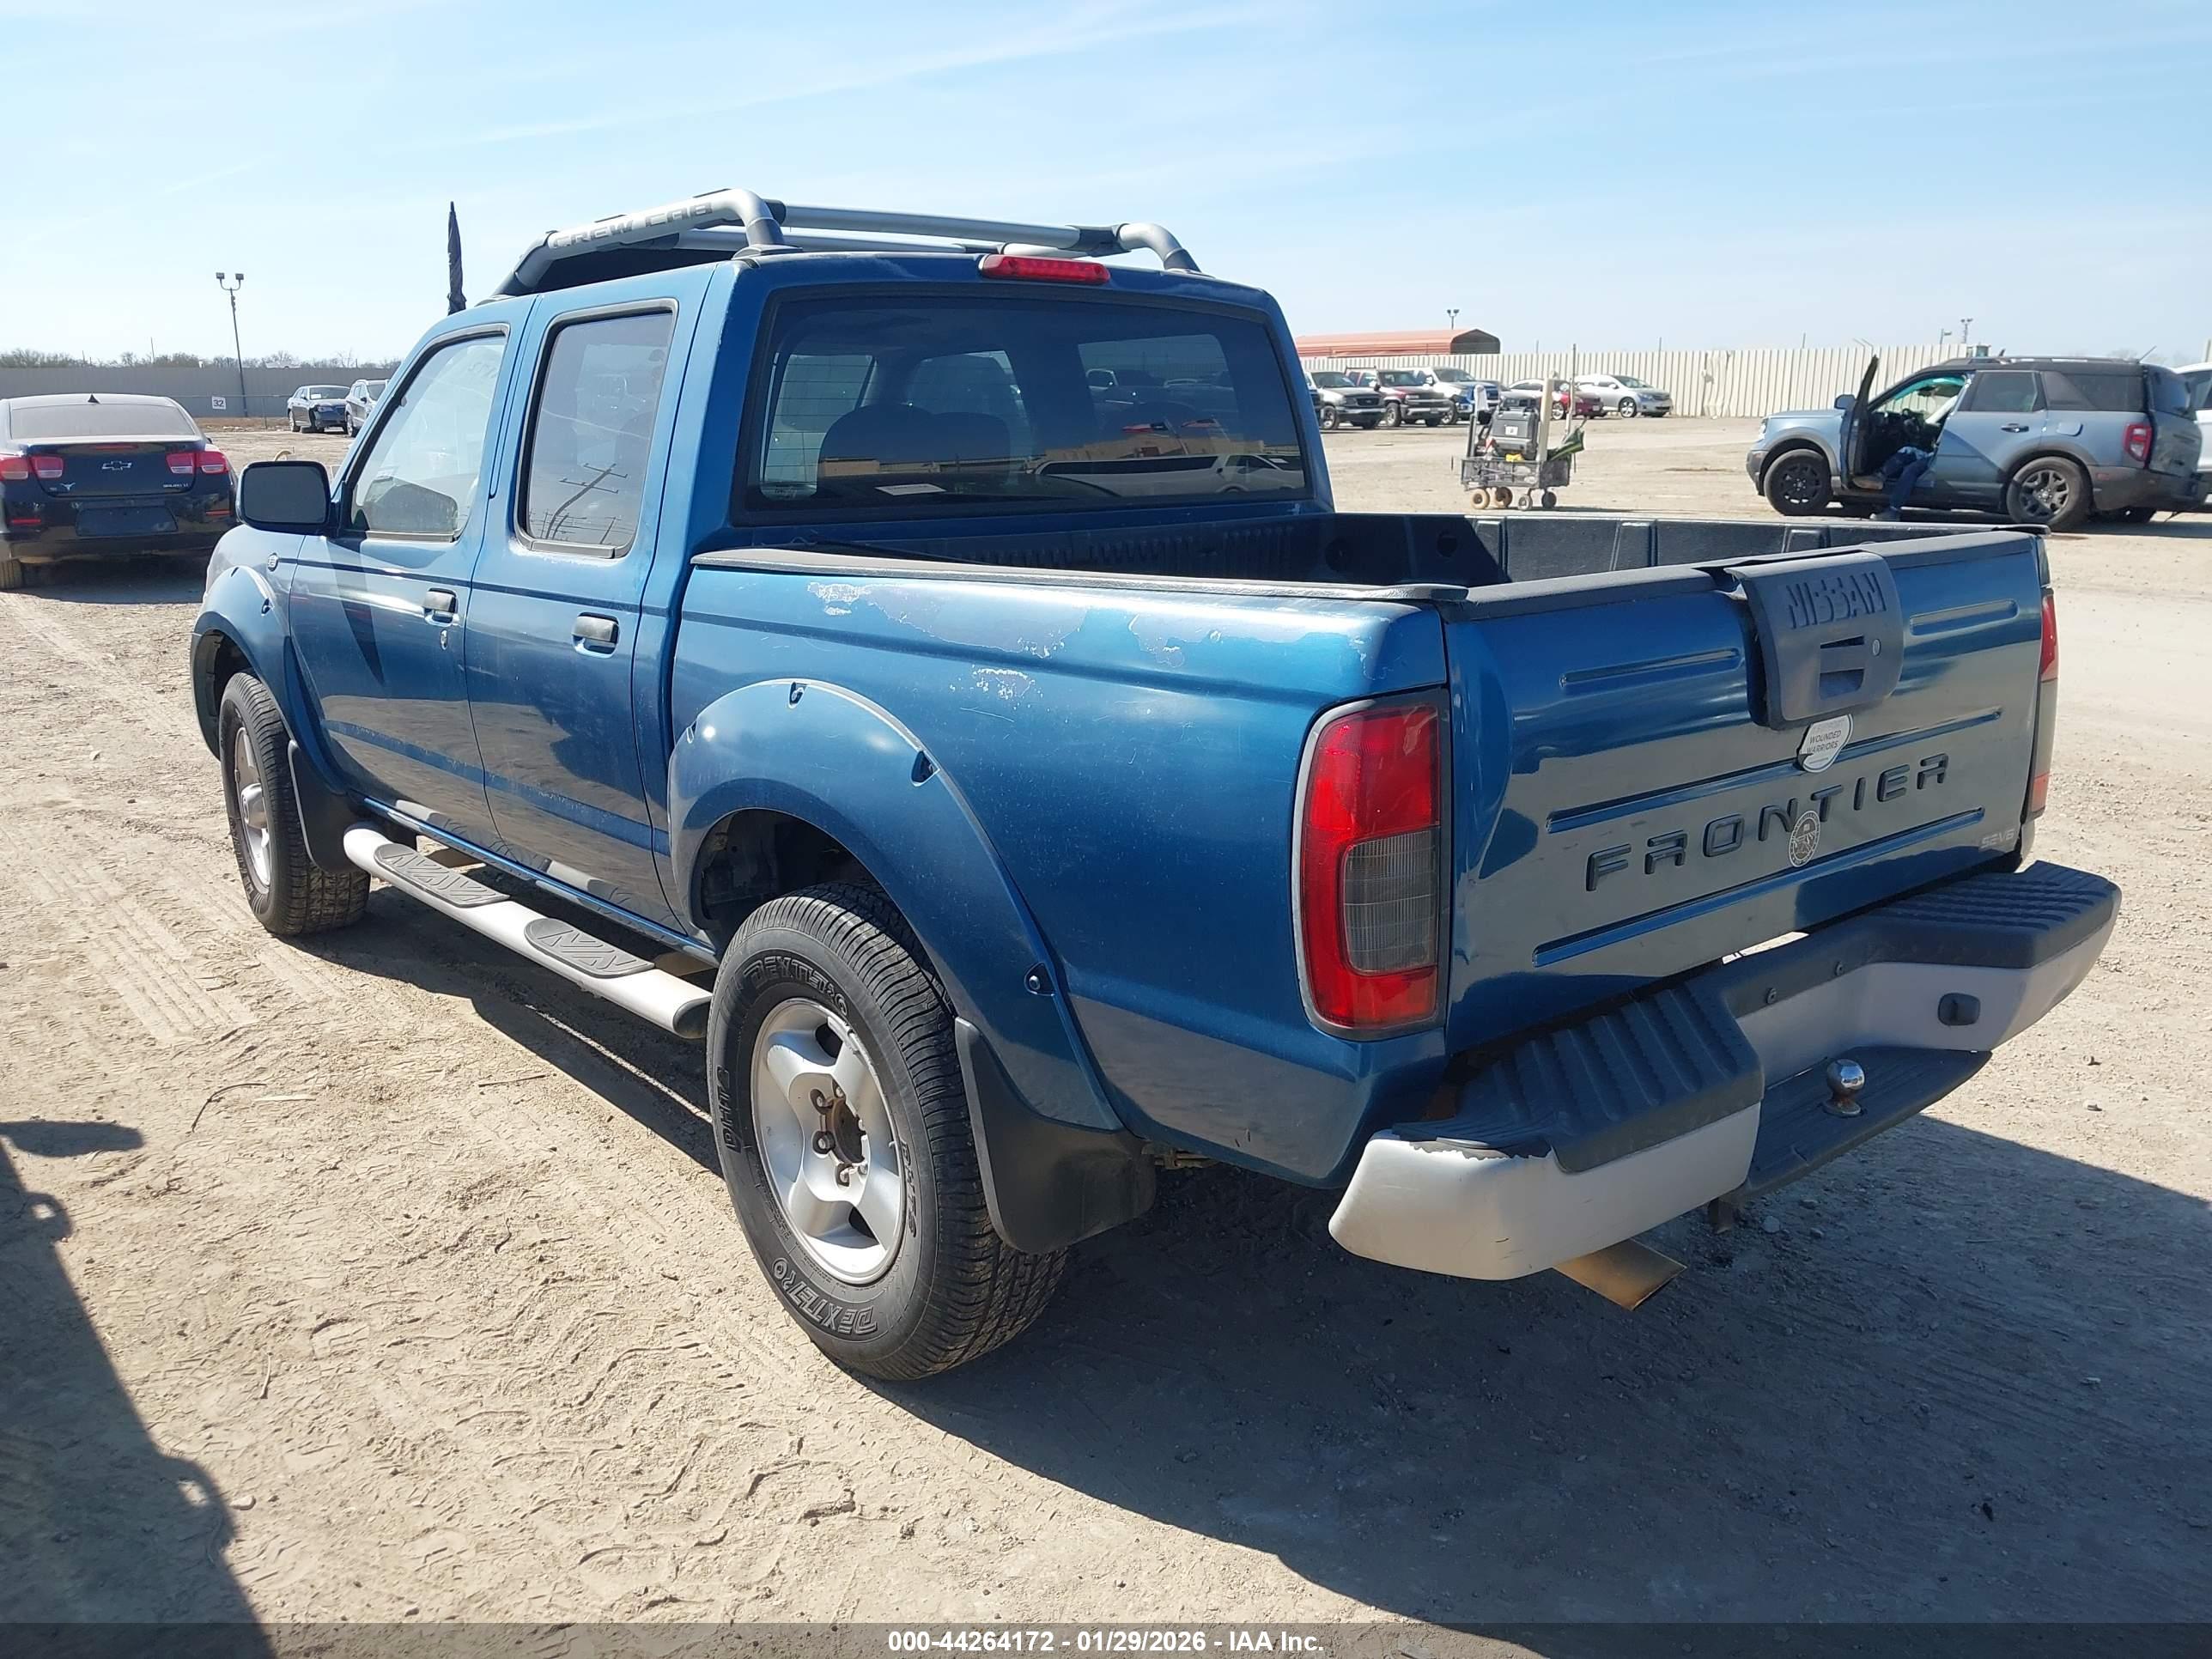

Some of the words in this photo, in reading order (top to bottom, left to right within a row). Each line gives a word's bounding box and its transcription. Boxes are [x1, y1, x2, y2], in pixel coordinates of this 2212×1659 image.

[552, 220, 634, 248] CREW
[644, 202, 714, 228] CAB
[1786, 571, 1887, 629] NISSAN
[1808, 730, 1842, 744] WOUNDED
[1585, 752, 1950, 892] FRONTIER
[772, 1257, 878, 1334] DEXTERO
